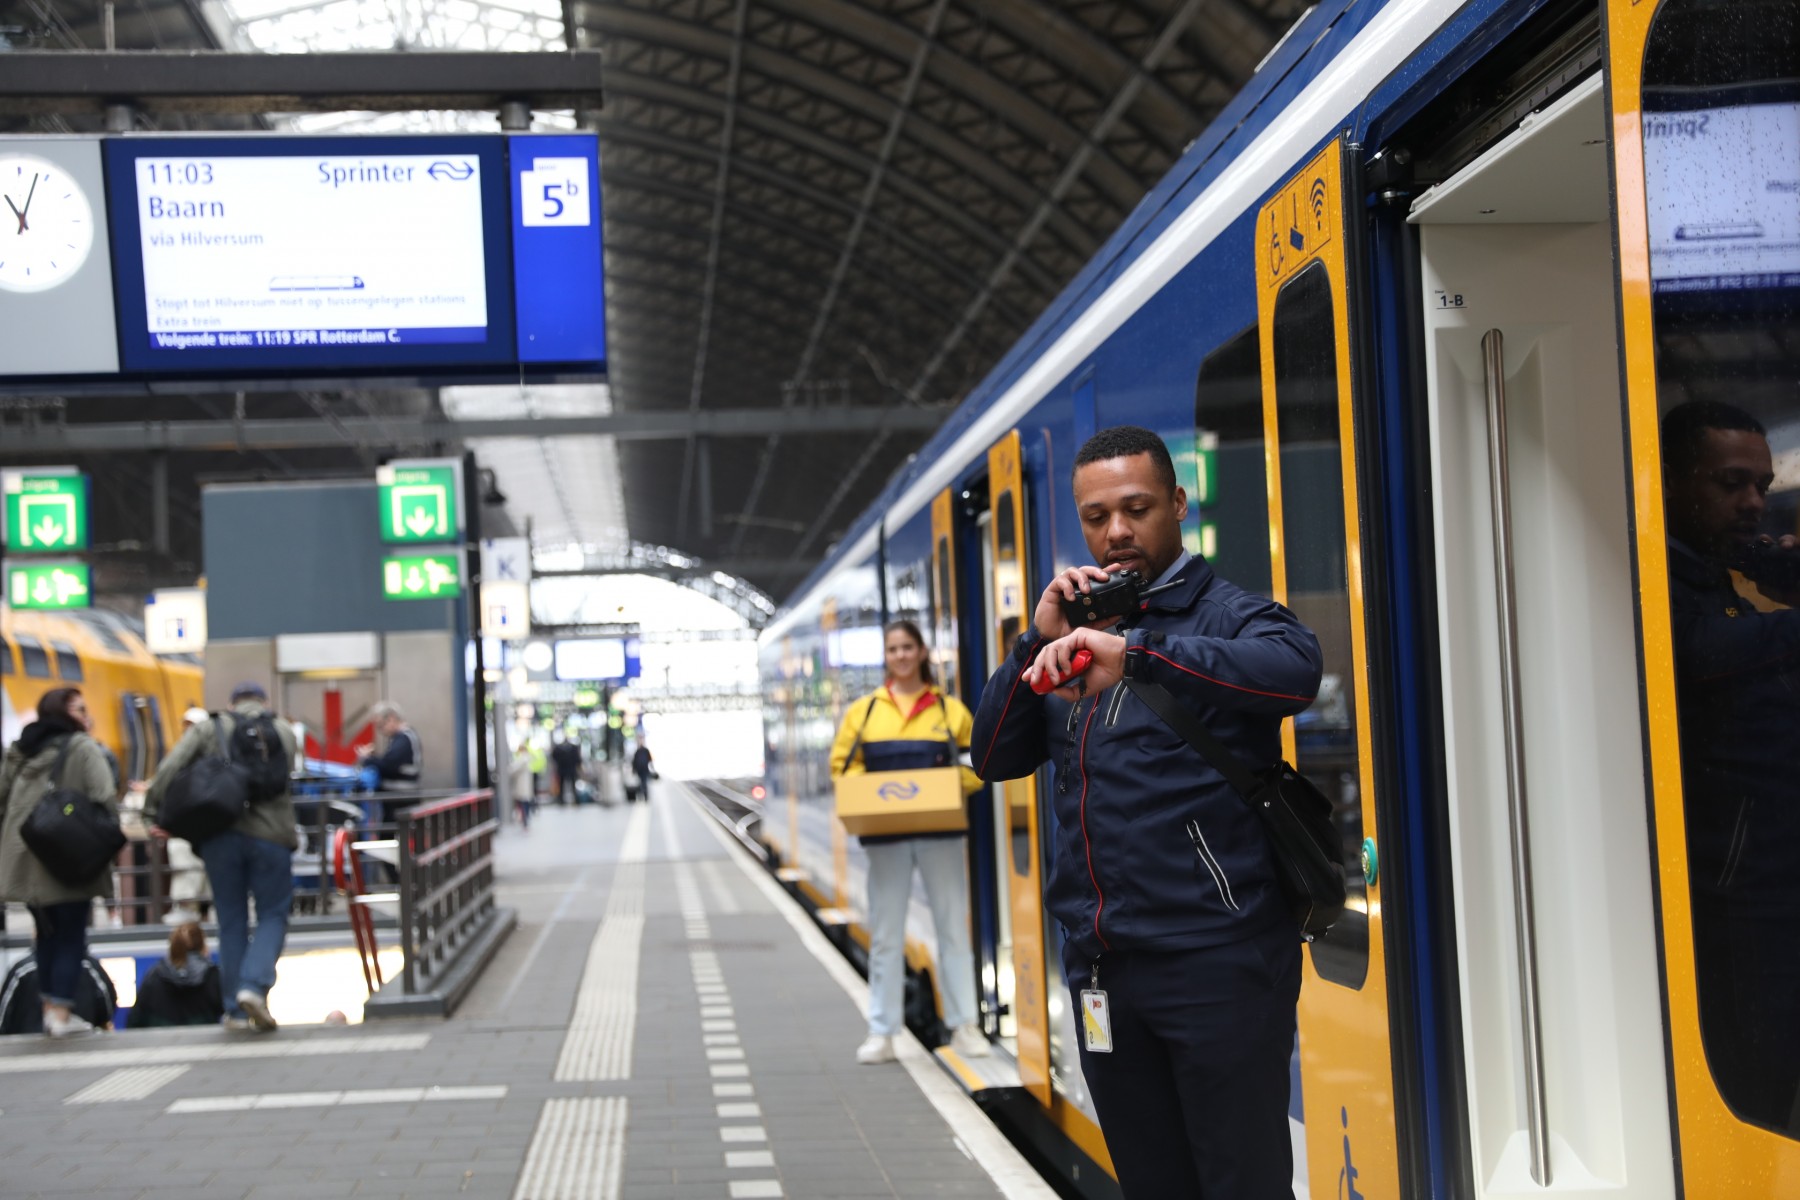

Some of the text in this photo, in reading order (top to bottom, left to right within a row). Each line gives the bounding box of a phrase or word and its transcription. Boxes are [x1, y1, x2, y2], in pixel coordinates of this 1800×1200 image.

[148, 163, 214, 185] 11:03
[318, 160, 414, 188] Sprinter
[149, 196, 225, 218] Baarn
[150, 231, 264, 246] via Hilversum
[215, 297, 276, 309] Hilversum
[1440, 294, 1464, 307] 1-B
[156, 316, 222, 328] Extra trein
[156, 333, 216, 350] Volgende
[256, 331, 291, 346] 11:19
[293, 330, 318, 345] SPR
[319, 329, 387, 345] Rotterdam
[498, 555, 517, 580] K
